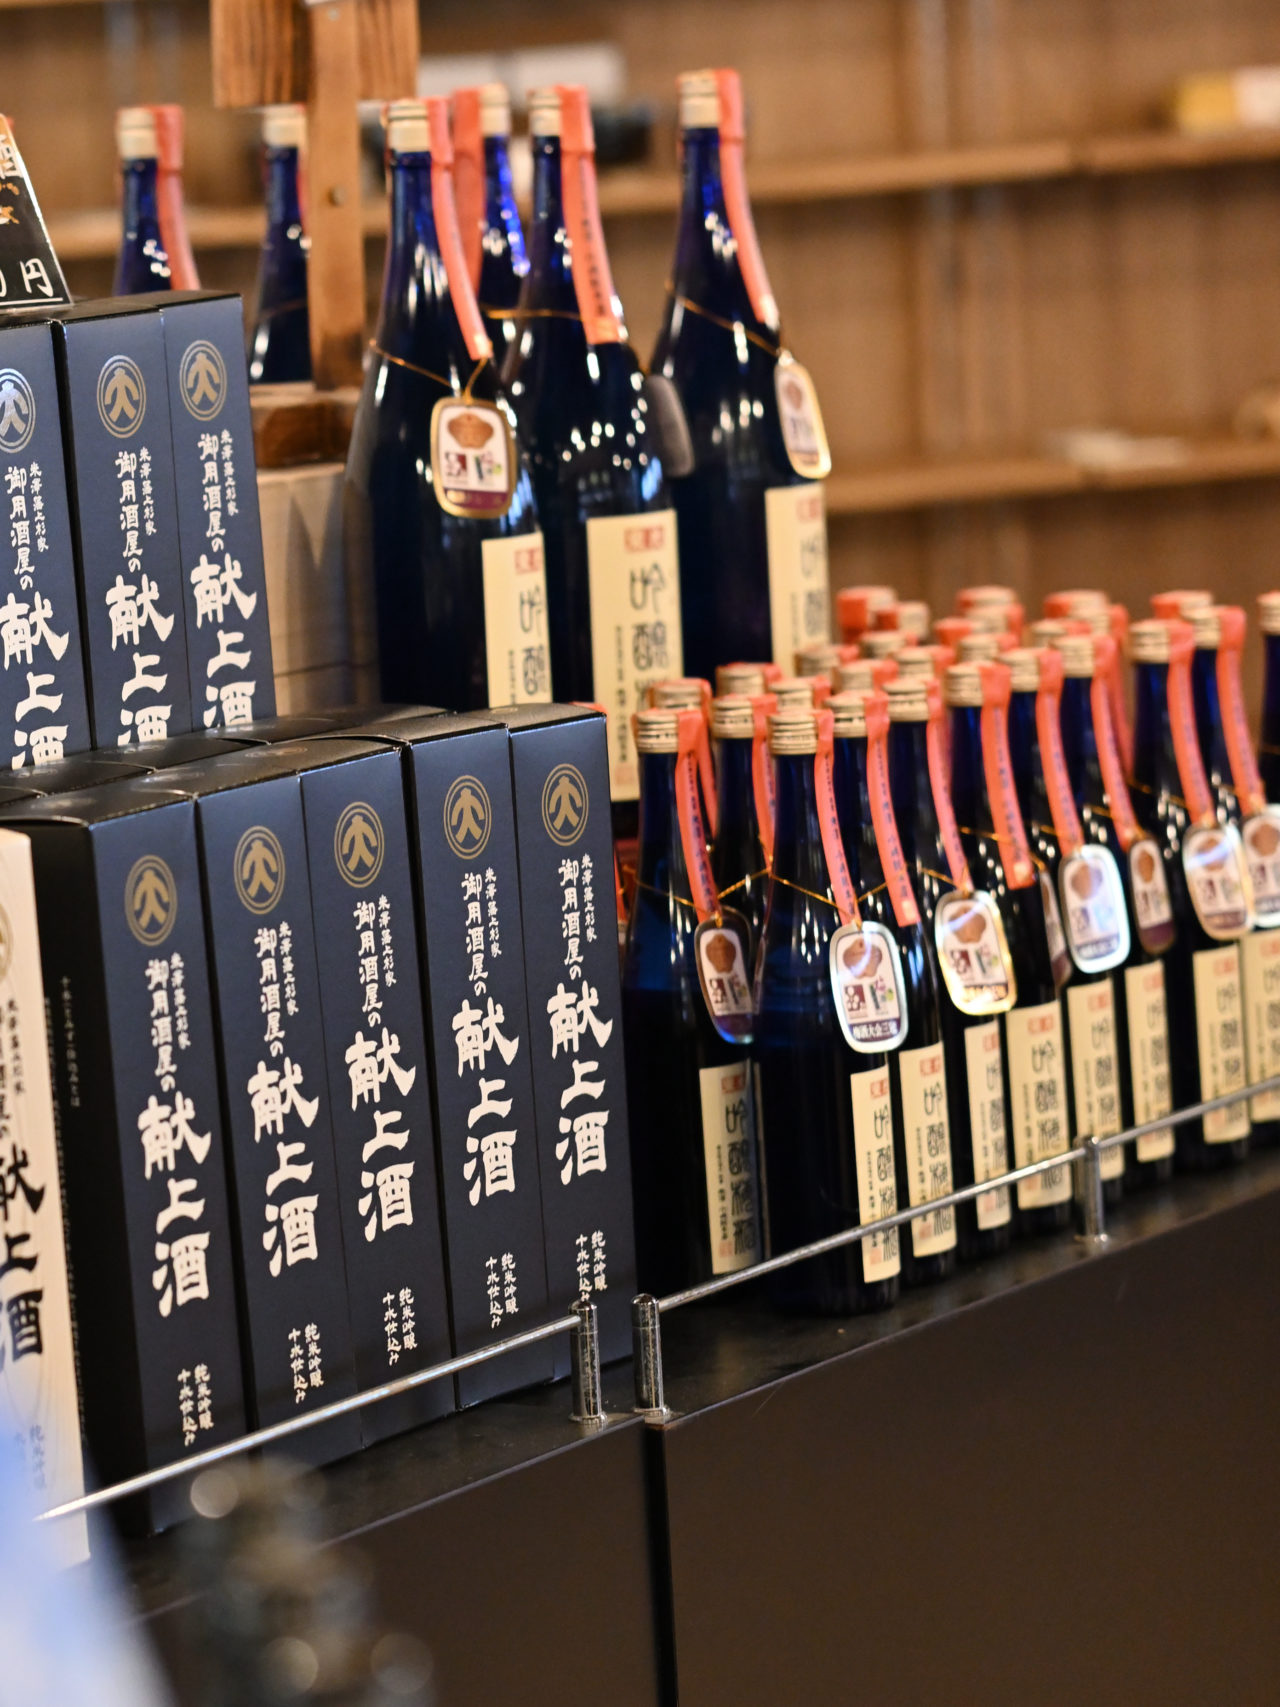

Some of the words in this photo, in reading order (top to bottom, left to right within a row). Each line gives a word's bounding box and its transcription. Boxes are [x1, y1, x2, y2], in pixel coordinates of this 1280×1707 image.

[4, 465, 35, 590] 御用酒屋の
[114, 450, 142, 573] 御用酒屋の
[197, 433, 225, 552] 御用酒屋の
[353, 900, 381, 1027] 御用酒屋の
[461, 872, 488, 997] 御用酒屋の
[558, 857, 584, 979] 御用酒屋の
[144, 957, 175, 1093] 御用酒屋の
[253, 926, 285, 1057] 御用酒屋の
[344, 1027, 416, 1243] 献上酒
[451, 997, 520, 1207] 献上酒
[547, 979, 614, 1186] 献上酒
[137, 1091, 211, 1318] 献上酒
[246, 1057, 319, 1277] 献上酒
[382, 1292, 401, 1366] 十水仕込み
[485, 1256, 503, 1329] 十水仕込み
